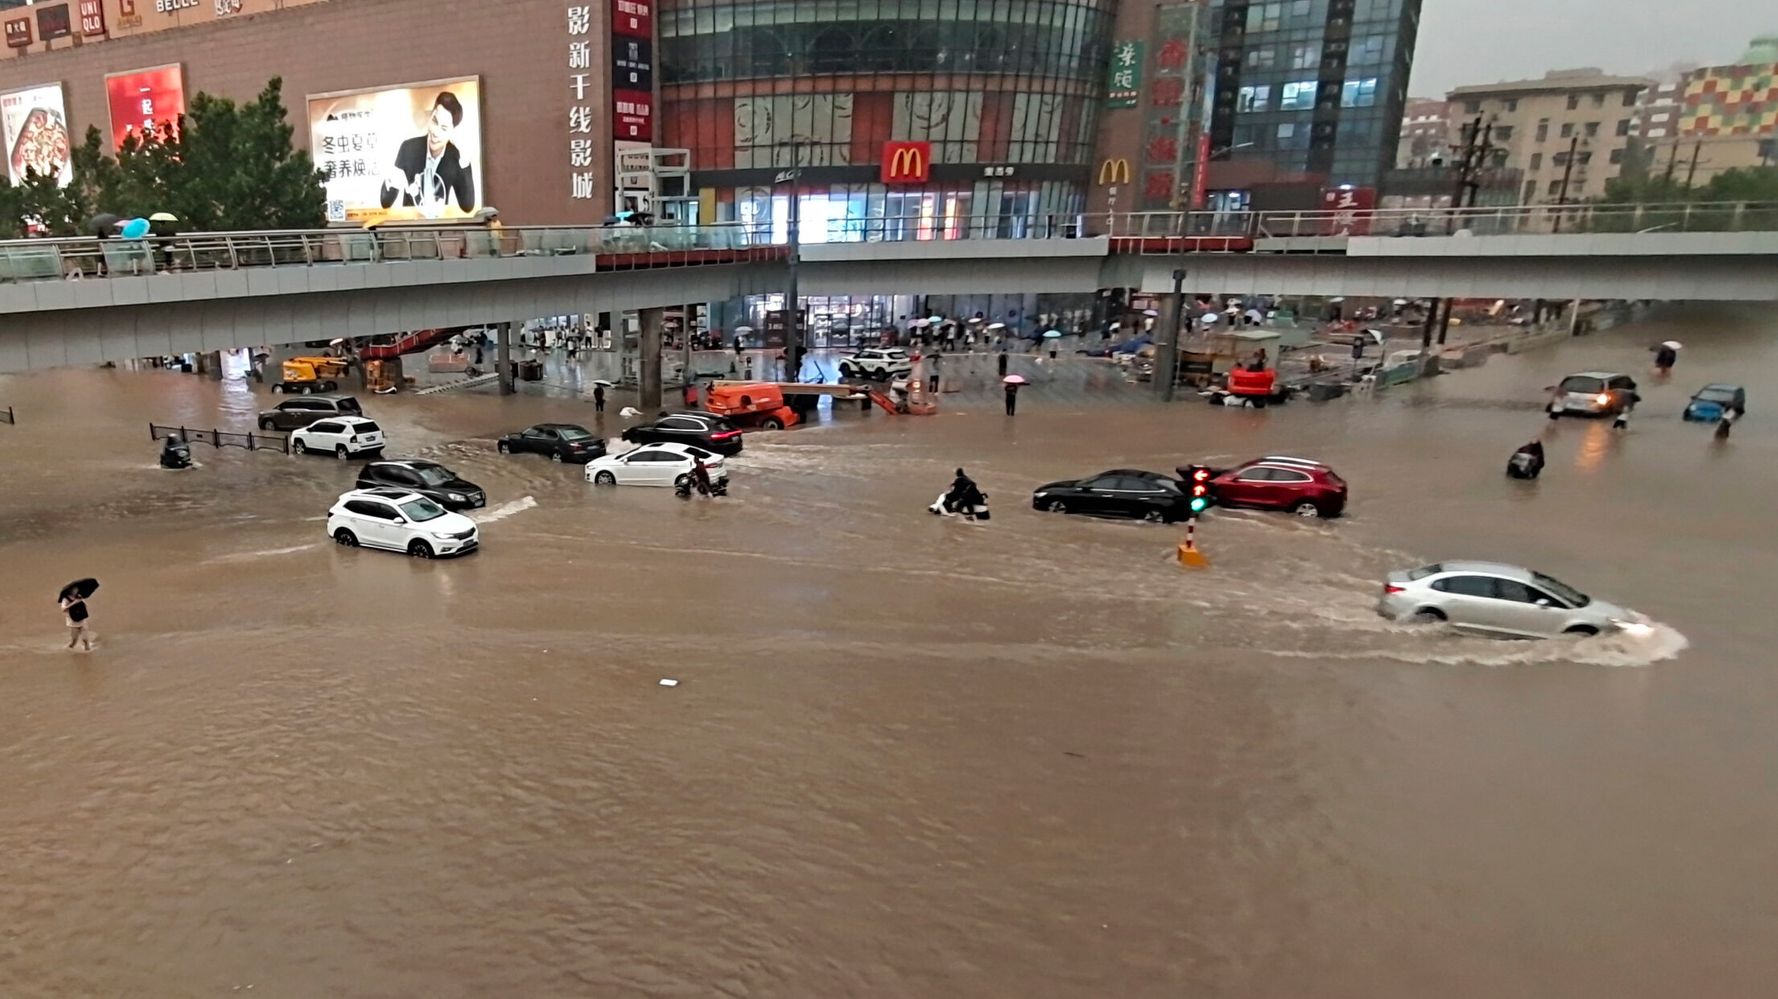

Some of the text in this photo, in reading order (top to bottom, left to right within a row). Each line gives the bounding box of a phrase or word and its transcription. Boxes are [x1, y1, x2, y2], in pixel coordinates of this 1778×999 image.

[81, 1, 98, 16] UNI
[82, 16, 101, 32] QLO
[567, 6, 594, 199] 影新干线影城
